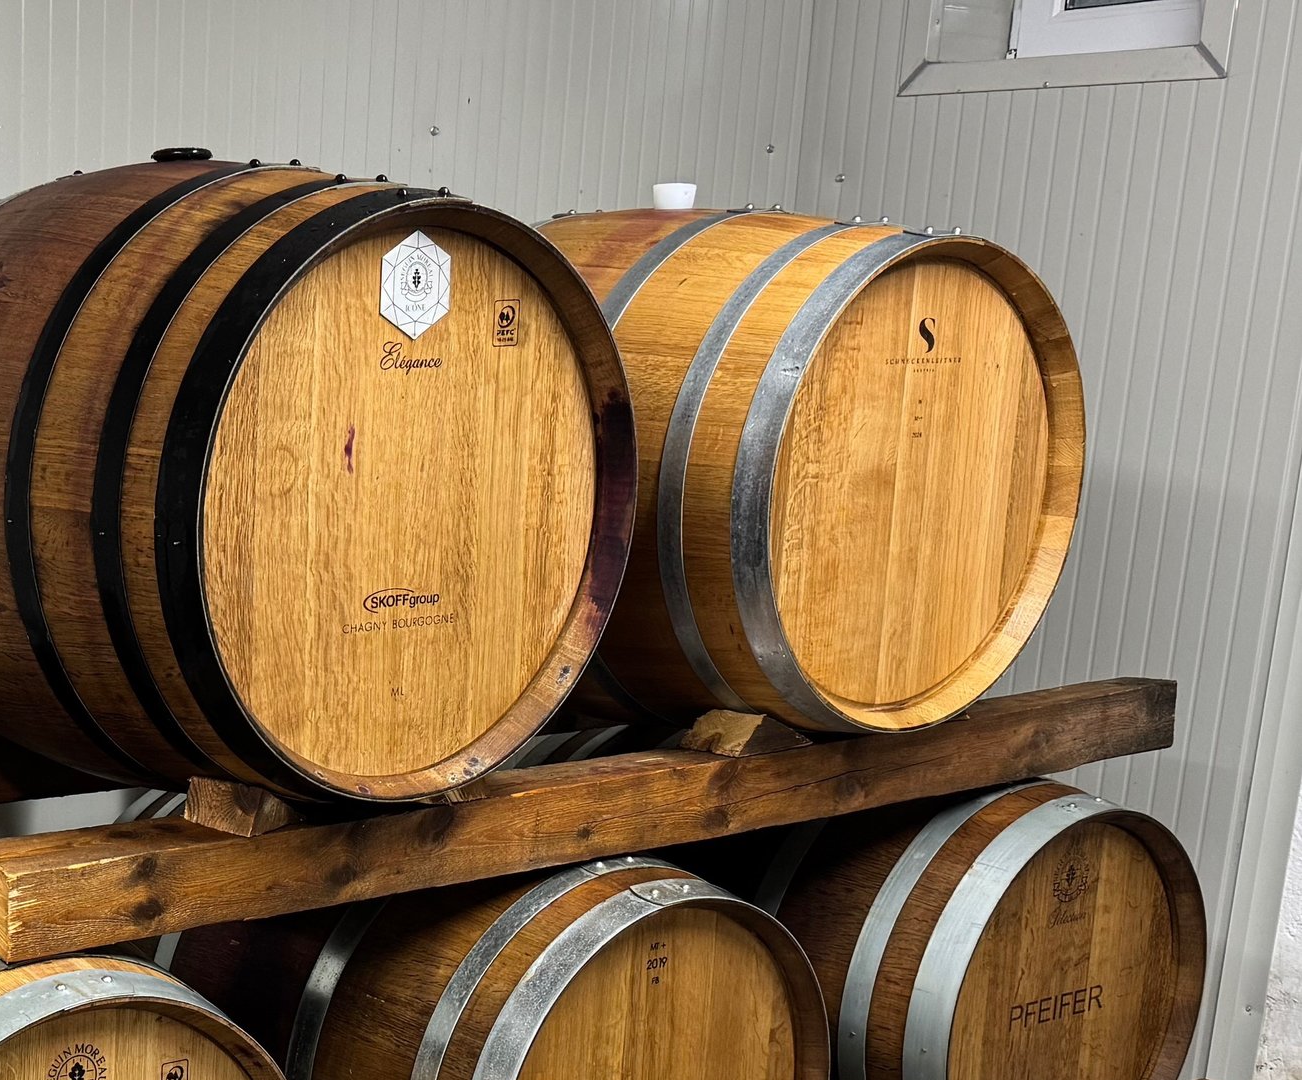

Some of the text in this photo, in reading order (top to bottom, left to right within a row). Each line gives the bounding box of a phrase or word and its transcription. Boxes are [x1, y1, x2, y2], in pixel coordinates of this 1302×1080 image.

[341, 613, 455, 634] CHAGNY BOURGOGNE
[646, 956, 668, 970] 2019
[1008, 984, 1103, 1032] PFEIFER
